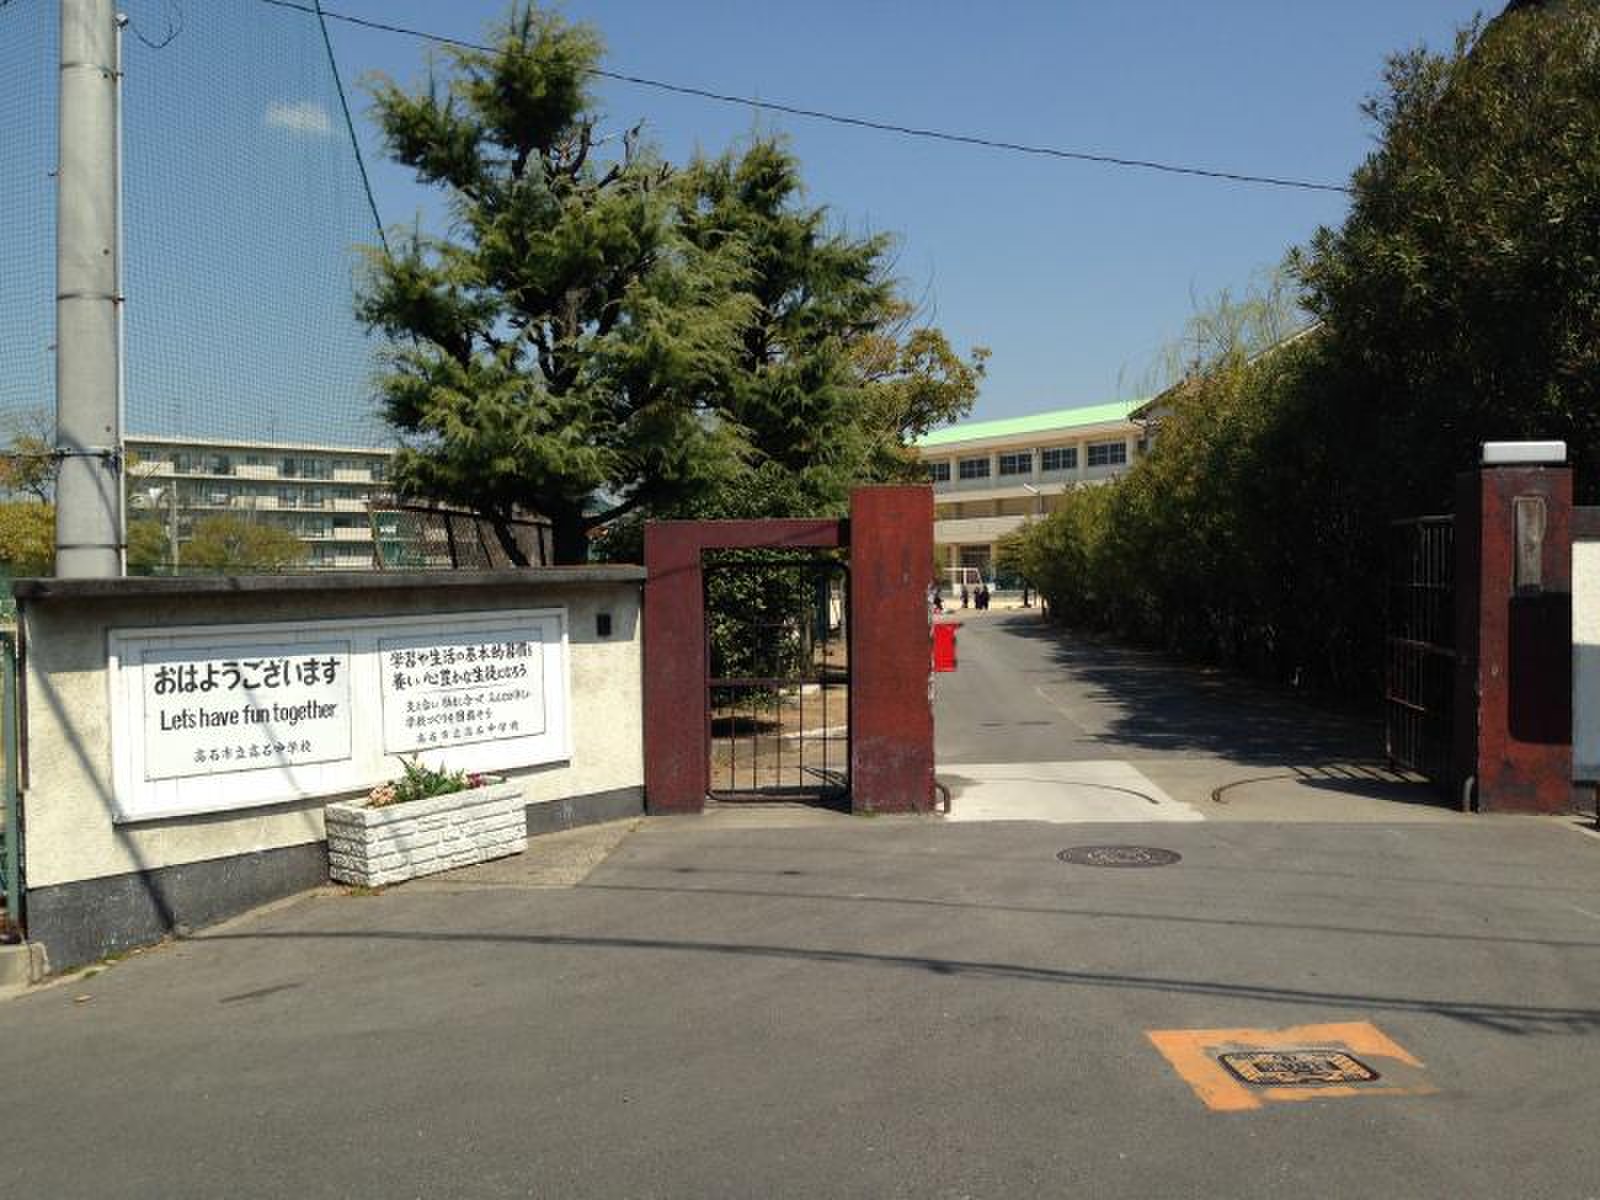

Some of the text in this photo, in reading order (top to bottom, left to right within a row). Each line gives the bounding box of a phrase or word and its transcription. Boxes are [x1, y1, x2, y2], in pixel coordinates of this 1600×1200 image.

[154, 656, 341, 695] おはようございます
[160, 700, 338, 731] Let's have fun together
[193, 739, 312, 763] 高石市立高石中学校
